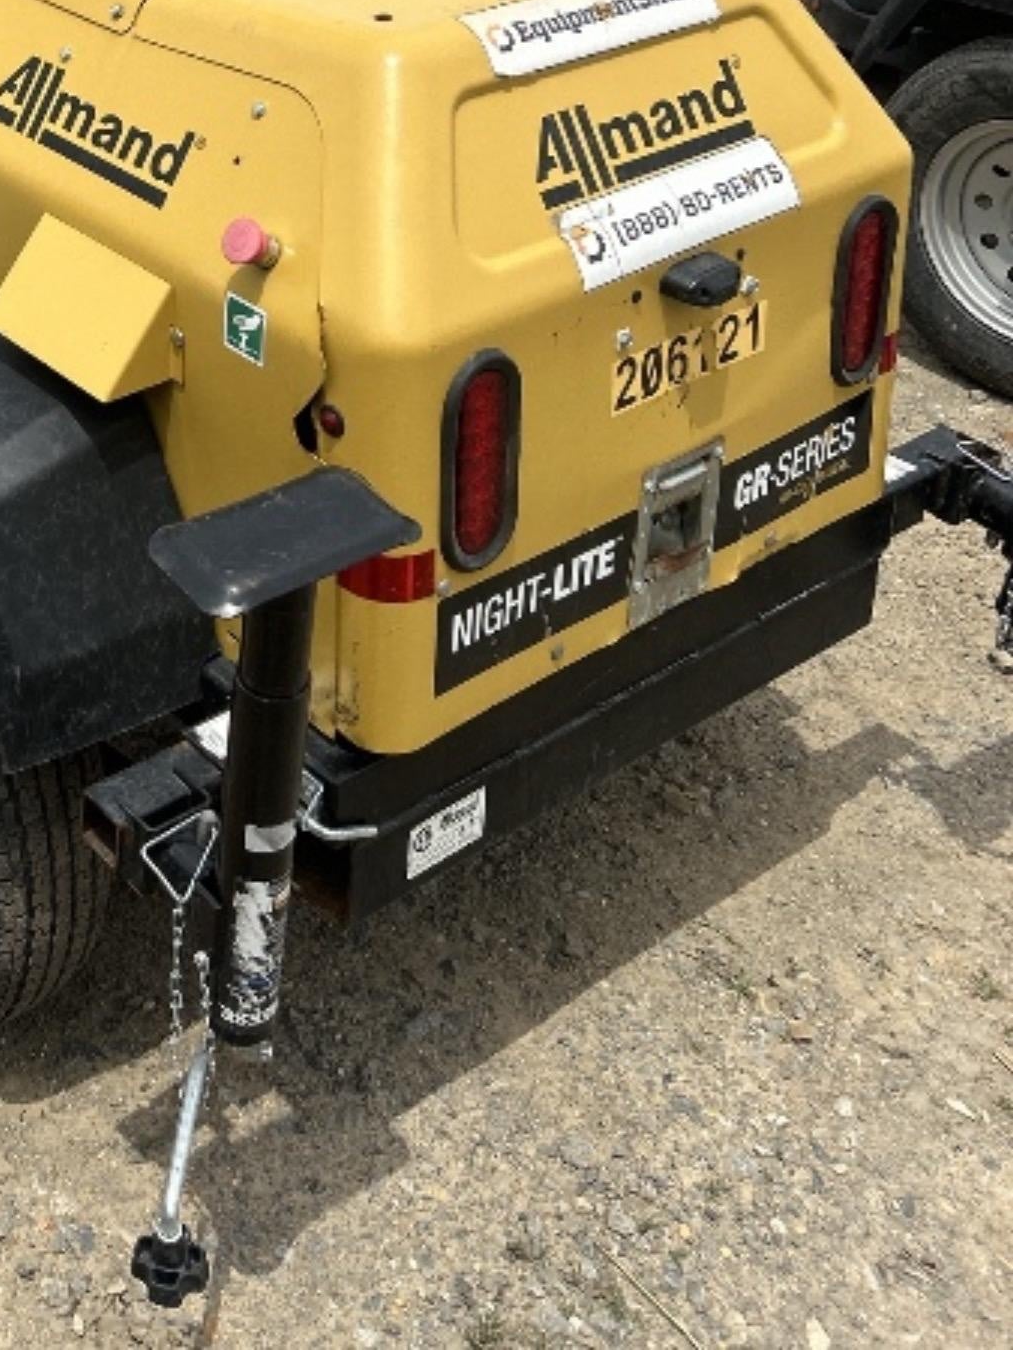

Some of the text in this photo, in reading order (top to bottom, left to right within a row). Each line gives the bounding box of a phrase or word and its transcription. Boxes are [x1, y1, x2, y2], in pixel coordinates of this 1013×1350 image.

[535, 59, 747, 196] Allmand
[611, 201, 678, 246] (888)
[614, 302, 761, 412] 206121
[733, 415, 856, 511] GR-SERIES
[451, 538, 616, 655] NIGHT-LITE
